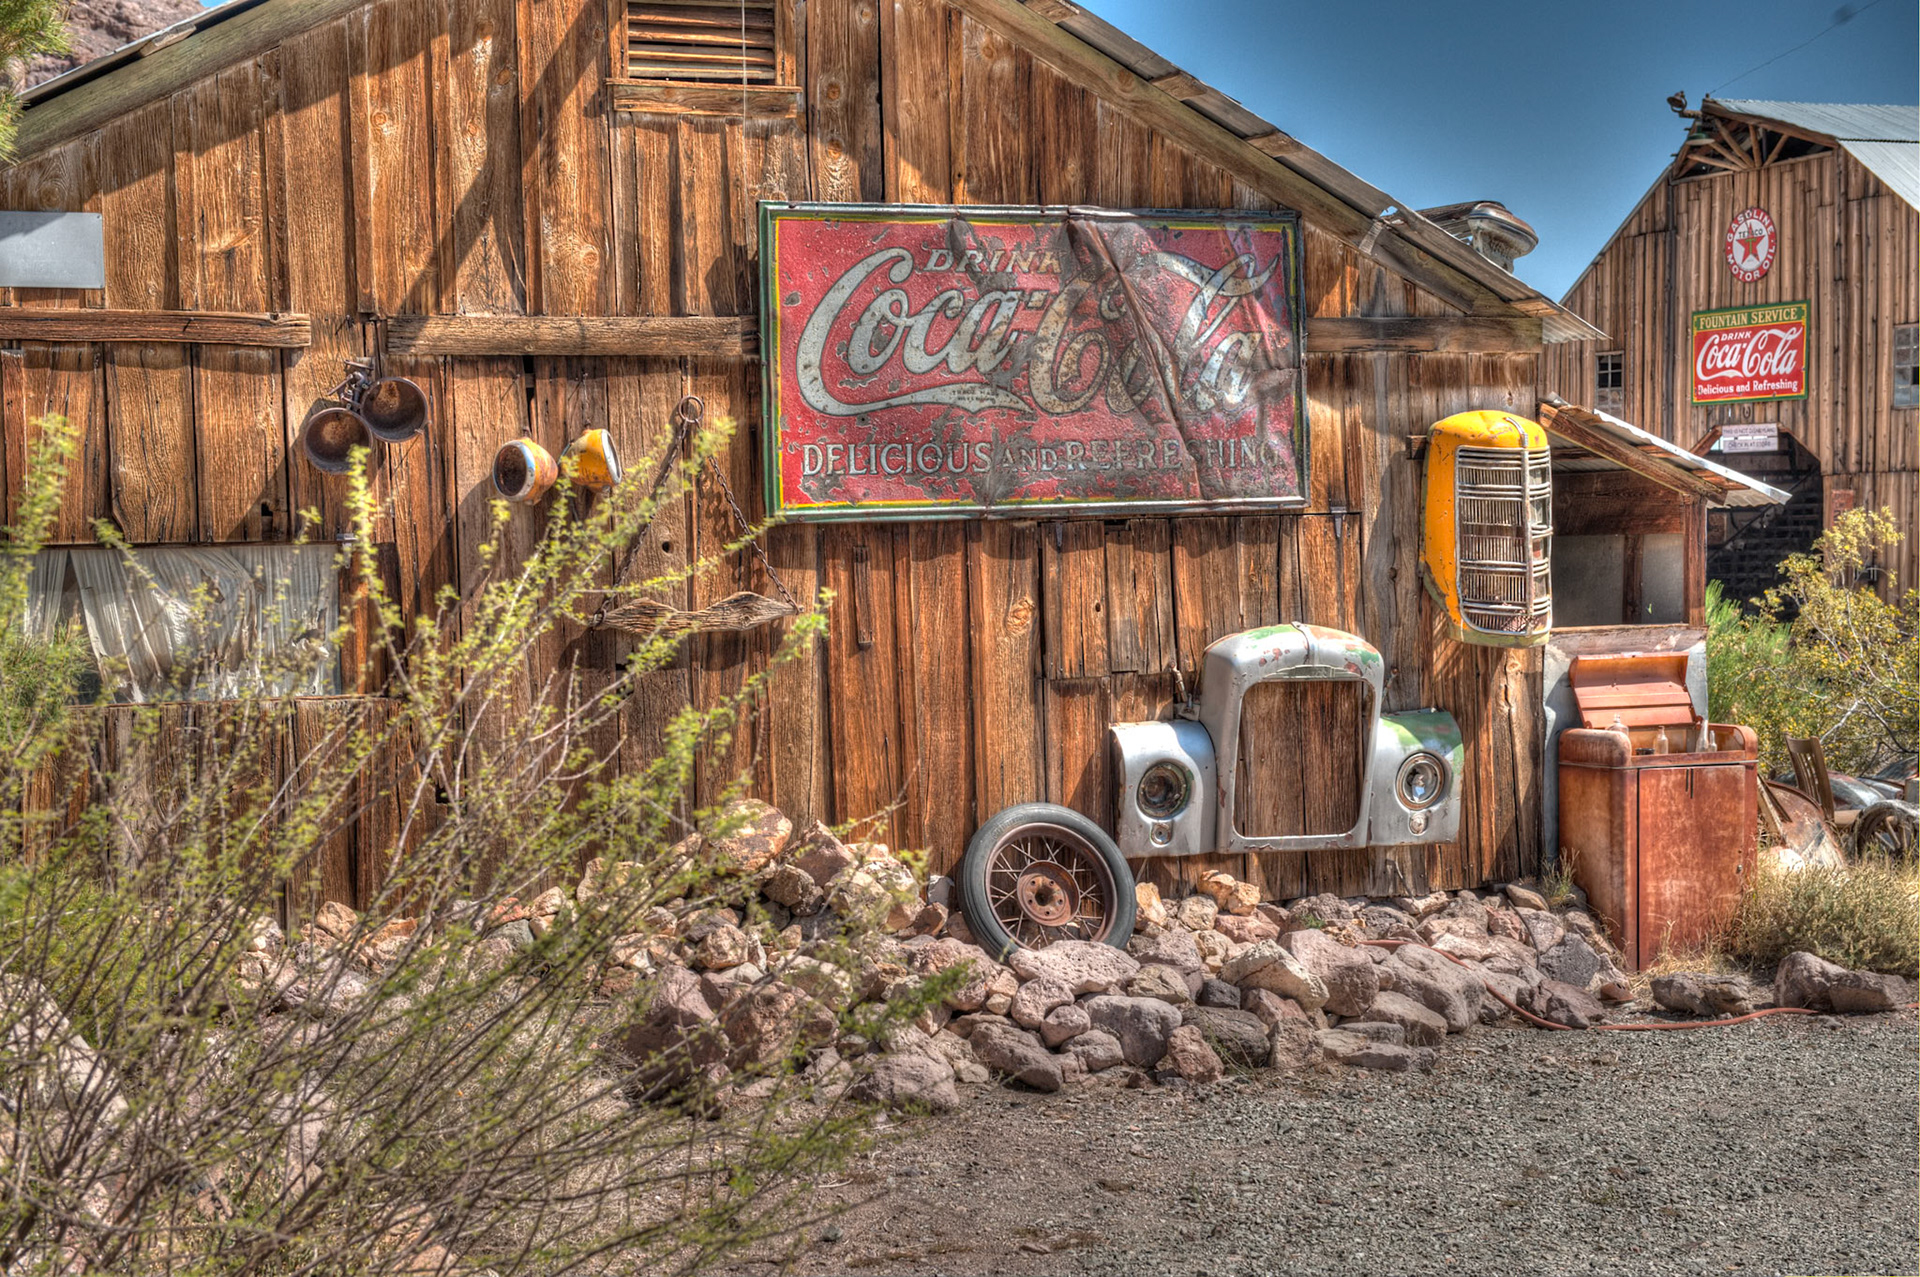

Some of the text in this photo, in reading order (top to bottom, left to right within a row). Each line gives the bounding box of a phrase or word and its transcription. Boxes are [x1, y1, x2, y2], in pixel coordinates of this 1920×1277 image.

[1727, 209, 1774, 242] GASOLINE
[923, 248, 1065, 273] DRINK
[1727, 245, 1776, 281] MOTOR OIL
[796, 247, 1279, 416] Coca-Cola
[1699, 307, 1798, 330] FOUNTAIN SERVICE
[1721, 331, 1752, 342] DRINK
[1696, 326, 1803, 381] Coca-Cola
[1698, 378, 1798, 396] Delicious and Refreshing
[802, 442, 992, 475] DELICIOUS
[1001, 447, 1060, 472] AND
